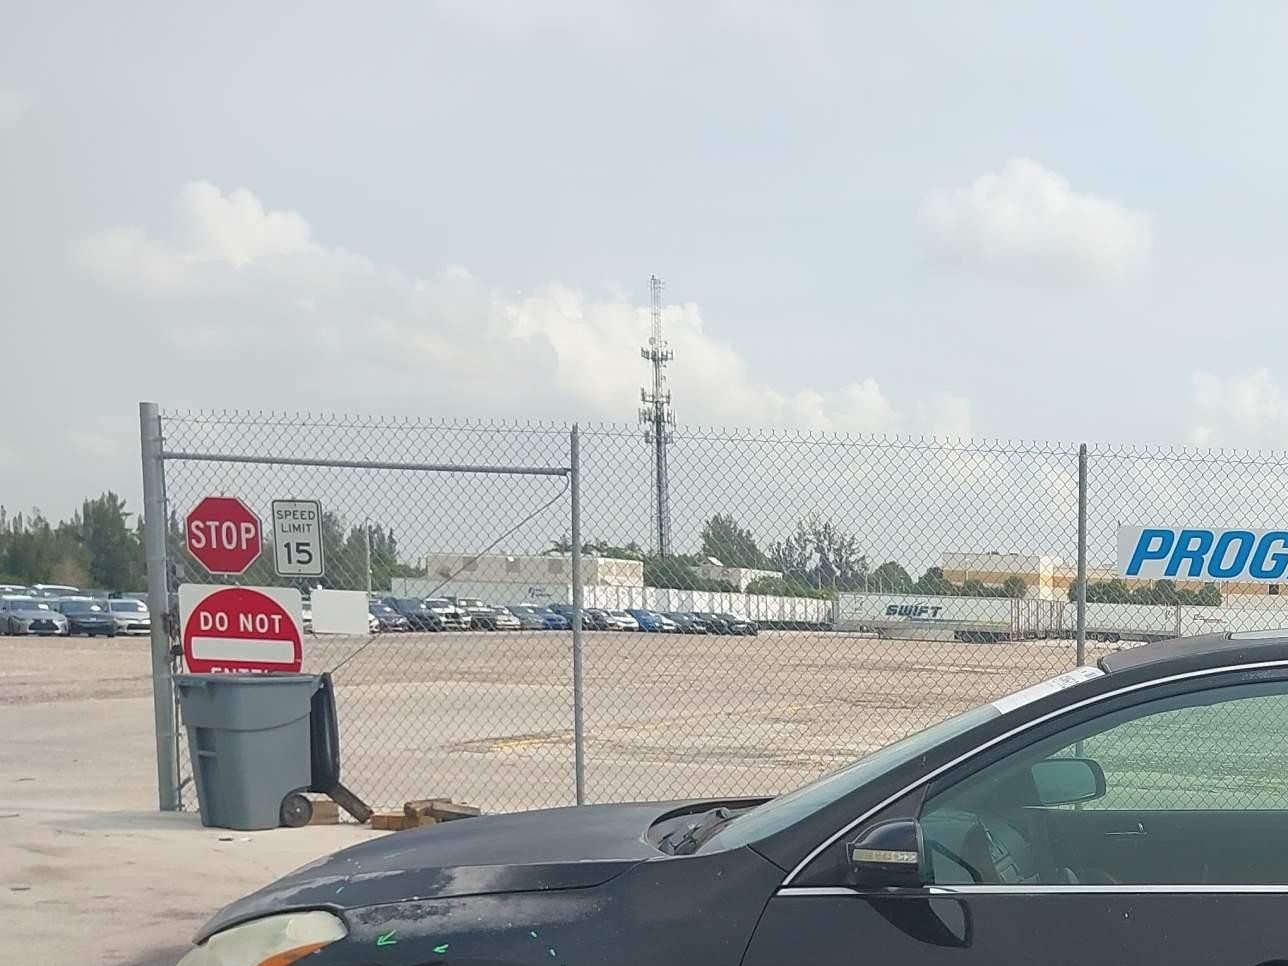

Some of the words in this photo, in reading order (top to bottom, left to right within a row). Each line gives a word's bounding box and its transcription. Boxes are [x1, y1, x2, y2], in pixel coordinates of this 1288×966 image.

[276, 509, 316, 521] SPEED
[190, 520, 256, 550] STOP
[281, 523, 313, 534] LIMIT
[283, 542, 313, 566] 15
[885, 603, 942, 618] SWIFT
[199, 611, 228, 632] DO
[239, 613, 283, 634] NOT
